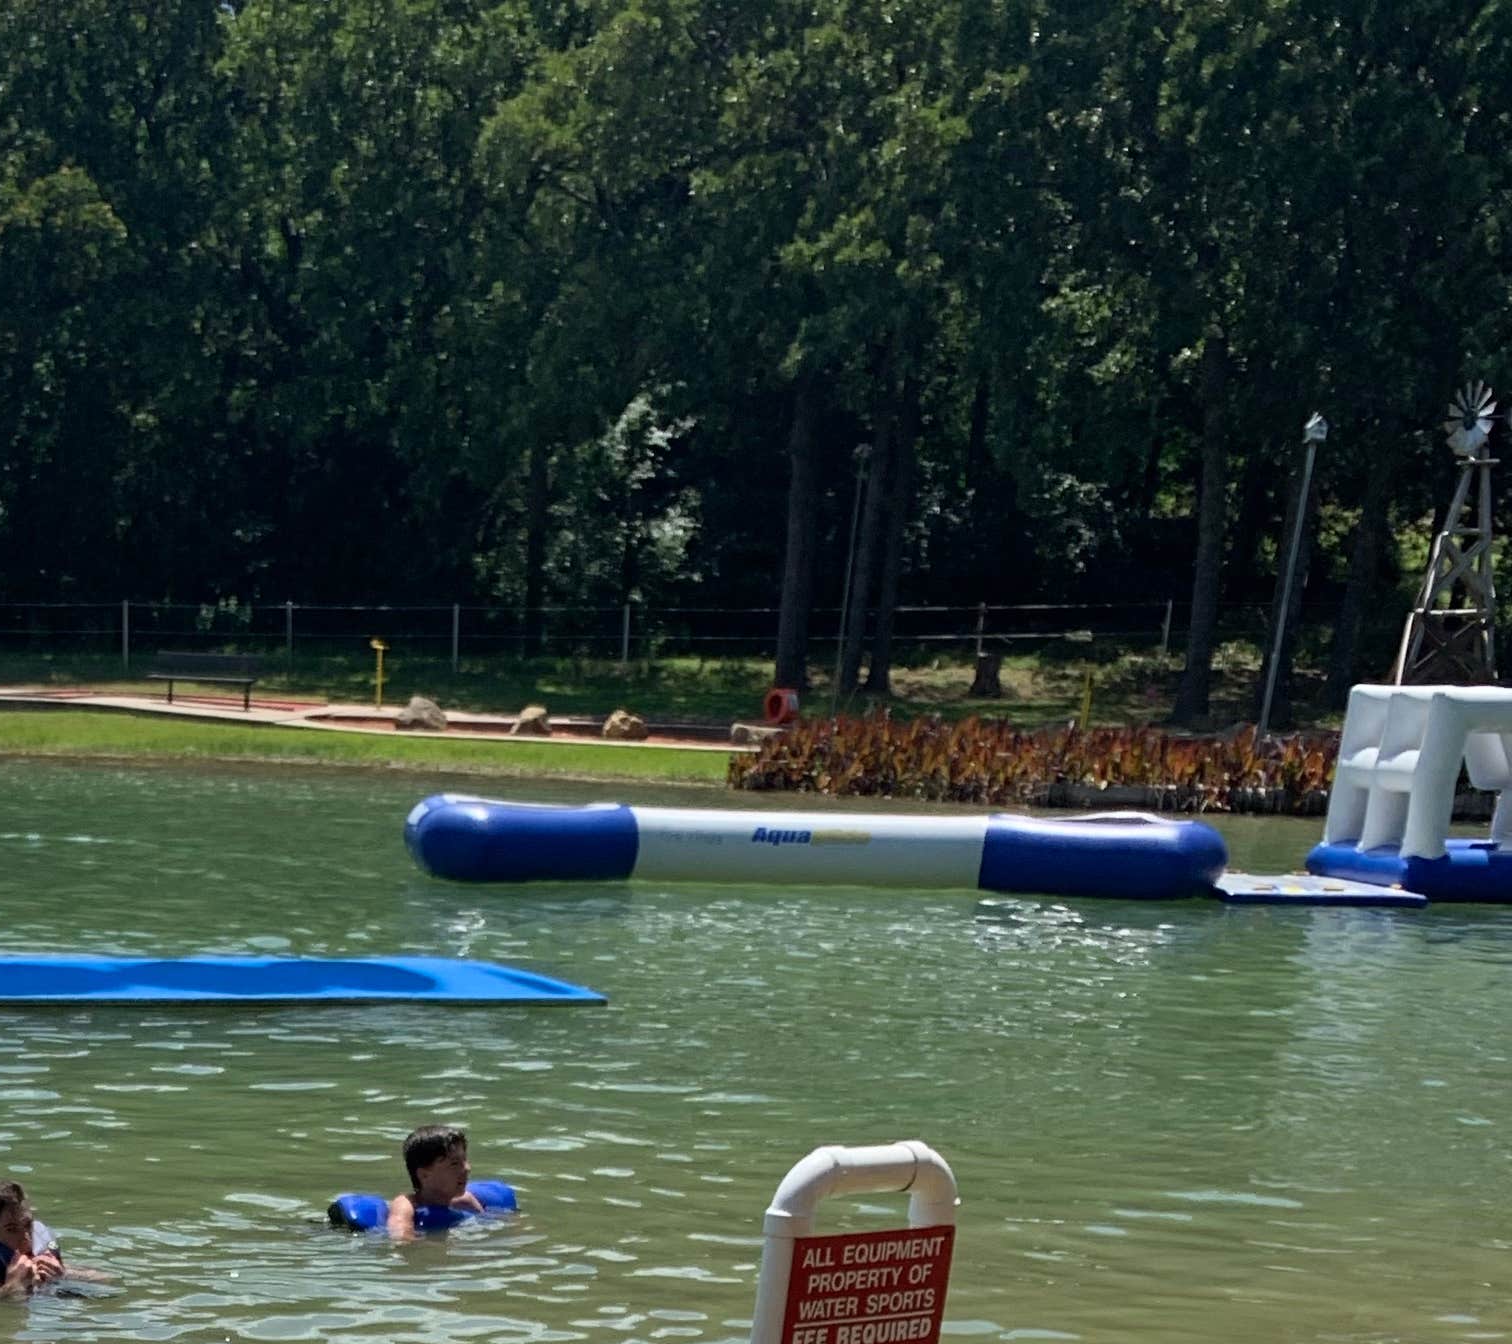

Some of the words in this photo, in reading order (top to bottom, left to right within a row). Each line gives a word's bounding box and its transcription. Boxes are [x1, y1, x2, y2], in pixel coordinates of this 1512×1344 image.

[802, 1248, 836, 1269] ALL
[843, 1237, 945, 1265] EQUIPMENT
[807, 1266, 903, 1294] PROPERTY
[908, 1264, 934, 1284] OF
[799, 1297, 858, 1320] WATER
[866, 1288, 936, 1314] SPORTS
